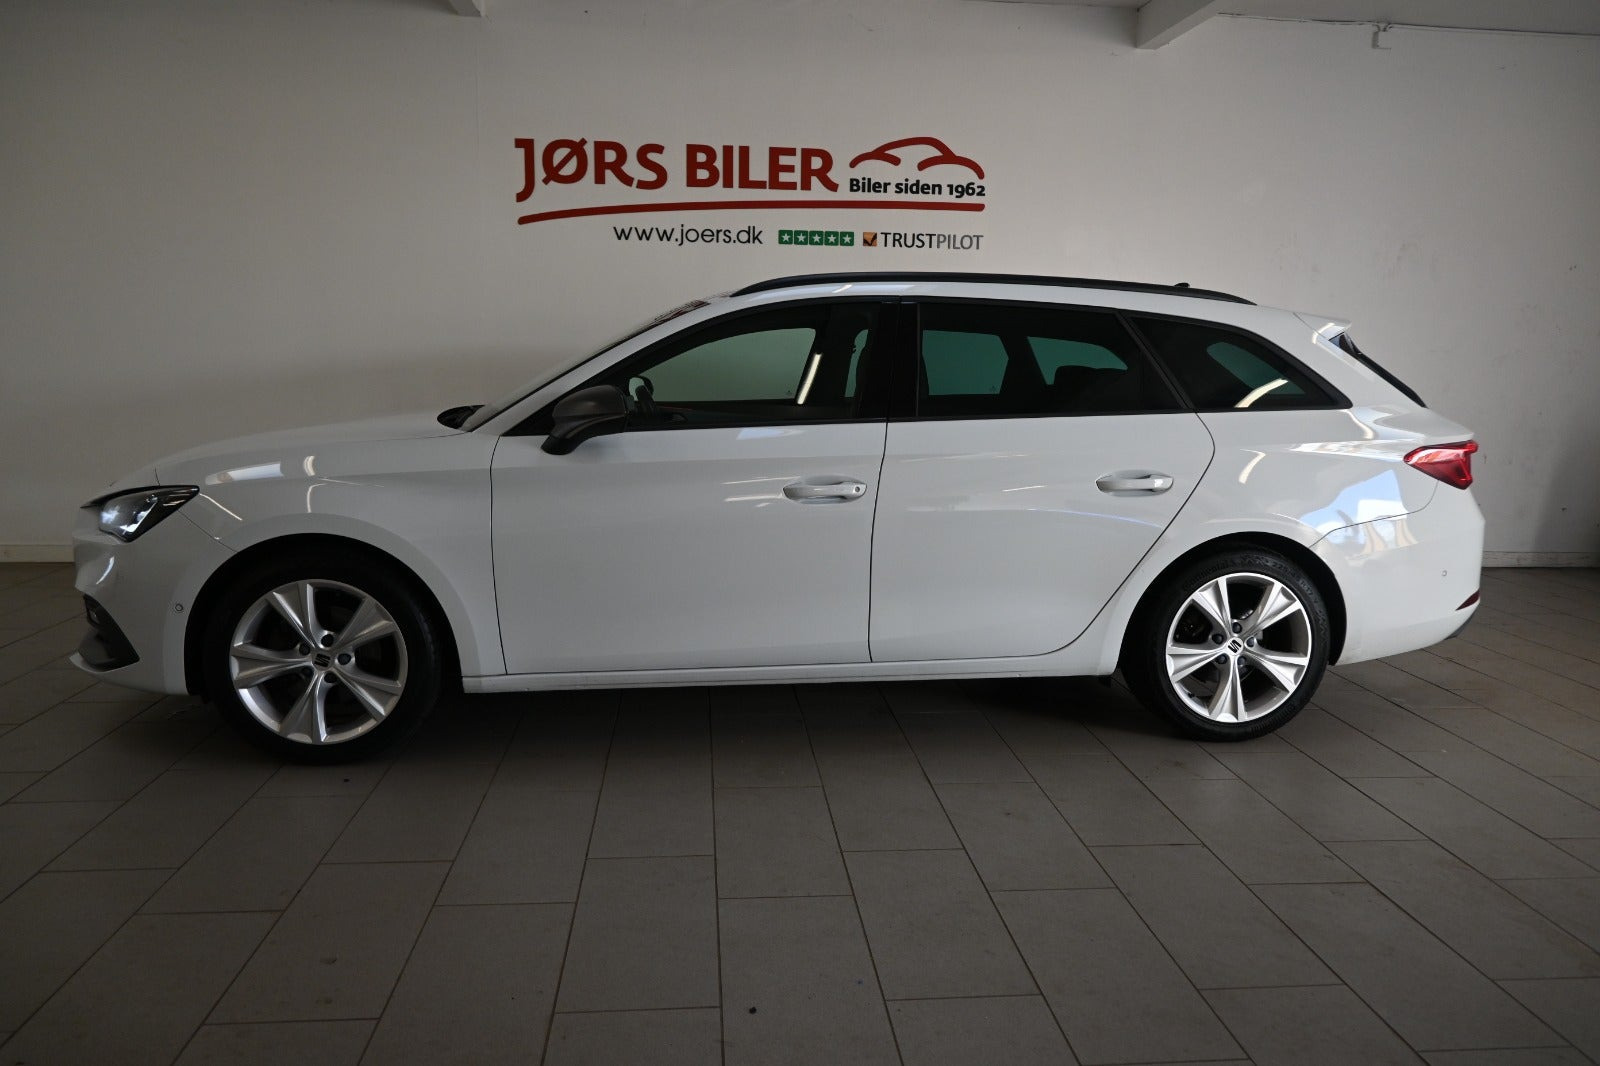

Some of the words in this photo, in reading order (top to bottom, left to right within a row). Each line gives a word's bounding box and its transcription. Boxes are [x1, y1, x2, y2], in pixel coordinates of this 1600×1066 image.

[515, 138, 667, 202] JØRS
[687, 144, 839, 192] BILER
[849, 177, 891, 194] Biler
[894, 178, 942, 196] siden
[946, 182, 986, 199] 1962
[612, 224, 764, 247] www.joers.dk
[881, 232, 984, 250] TRUSTPILOT
